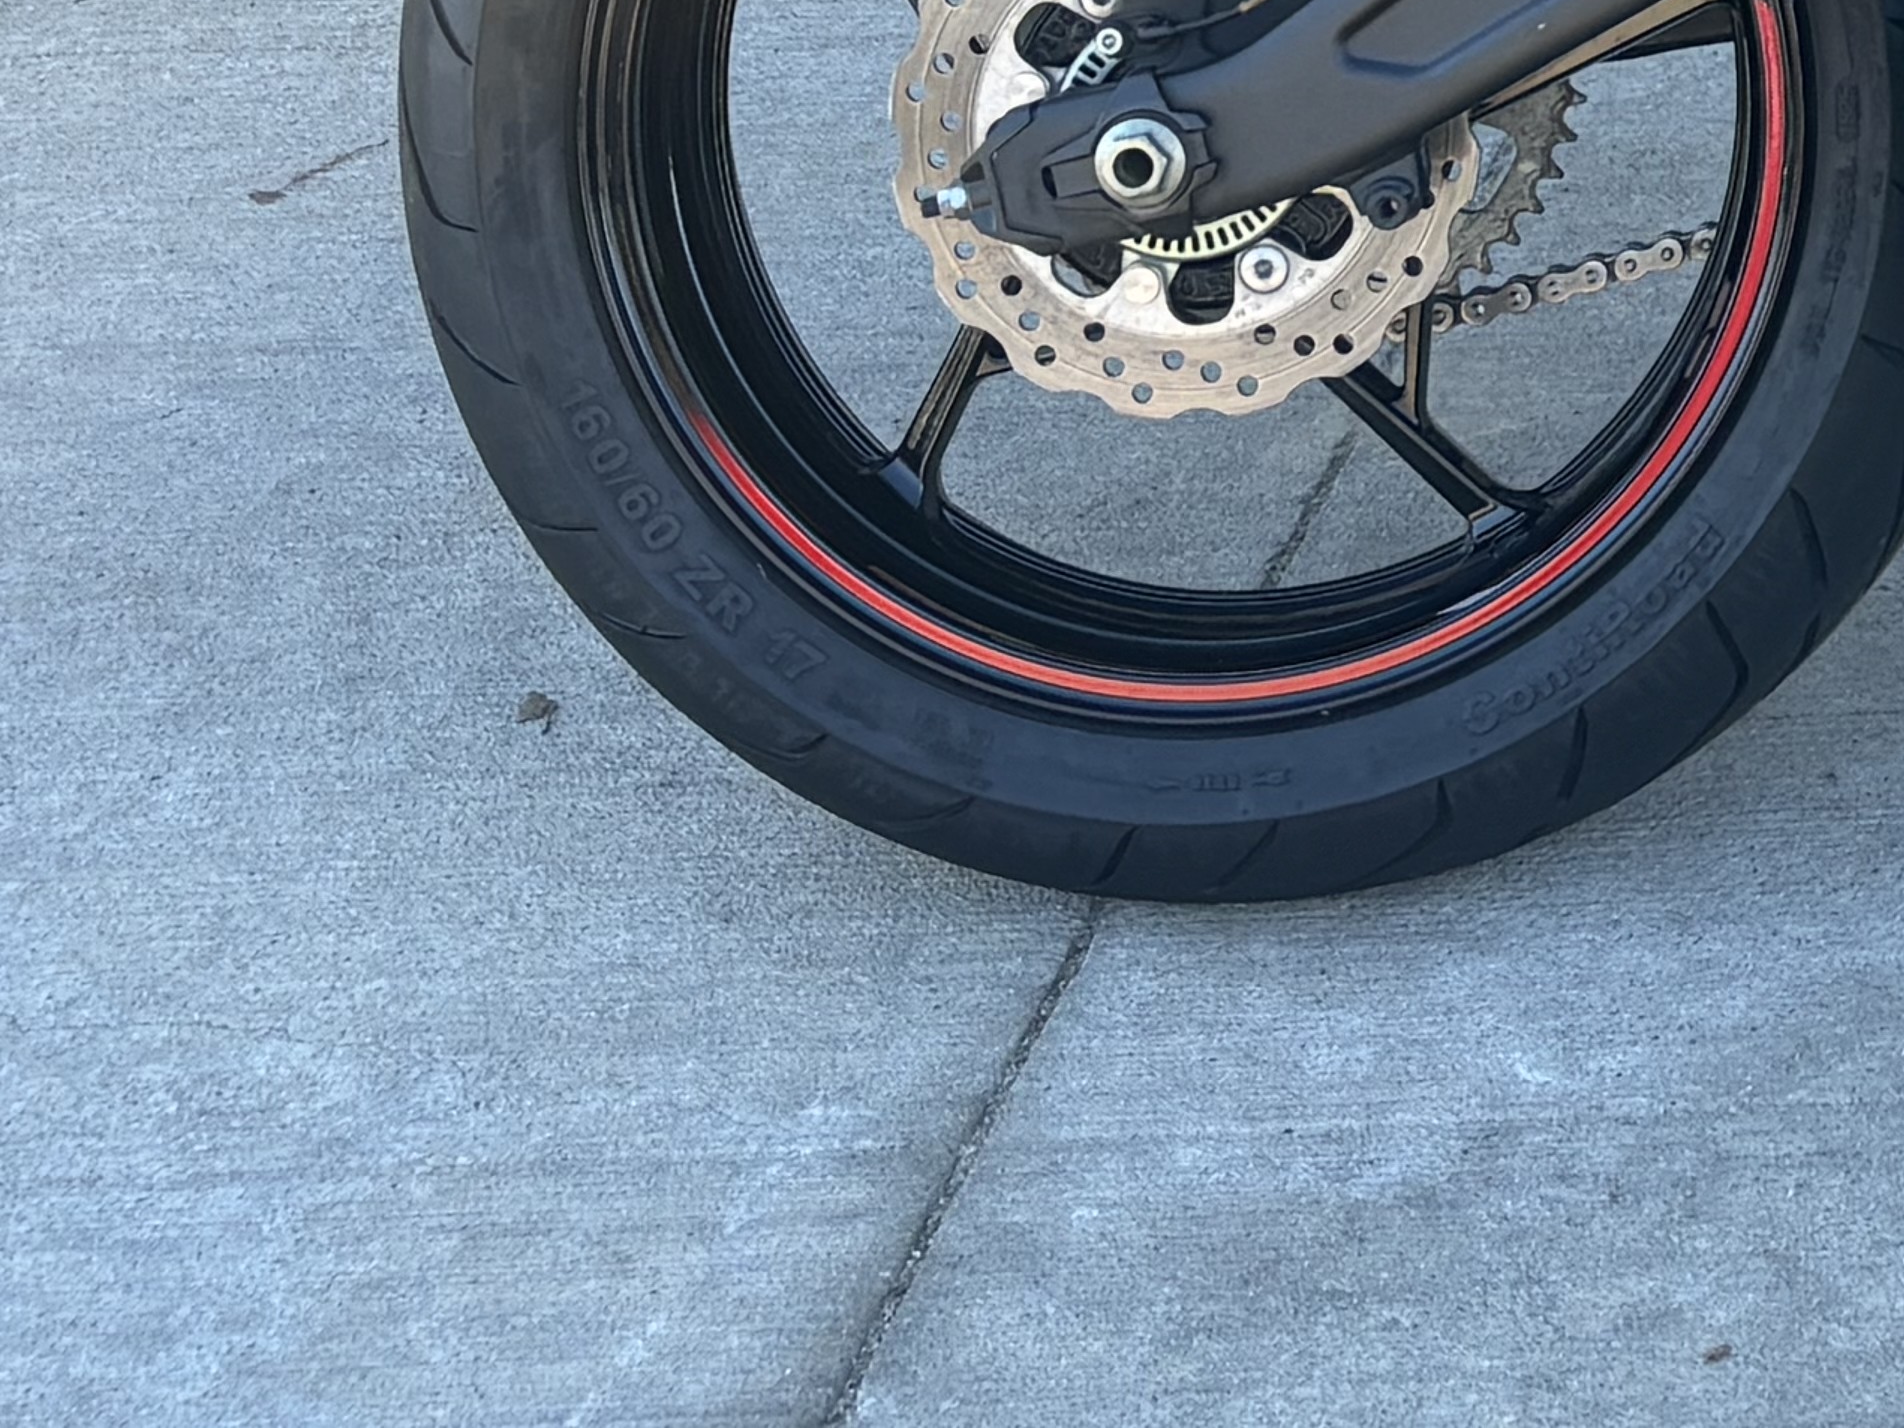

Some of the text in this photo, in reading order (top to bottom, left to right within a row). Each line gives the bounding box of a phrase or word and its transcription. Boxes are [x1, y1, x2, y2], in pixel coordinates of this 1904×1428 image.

[560, 381, 827, 684] 160/60 ZR 17
